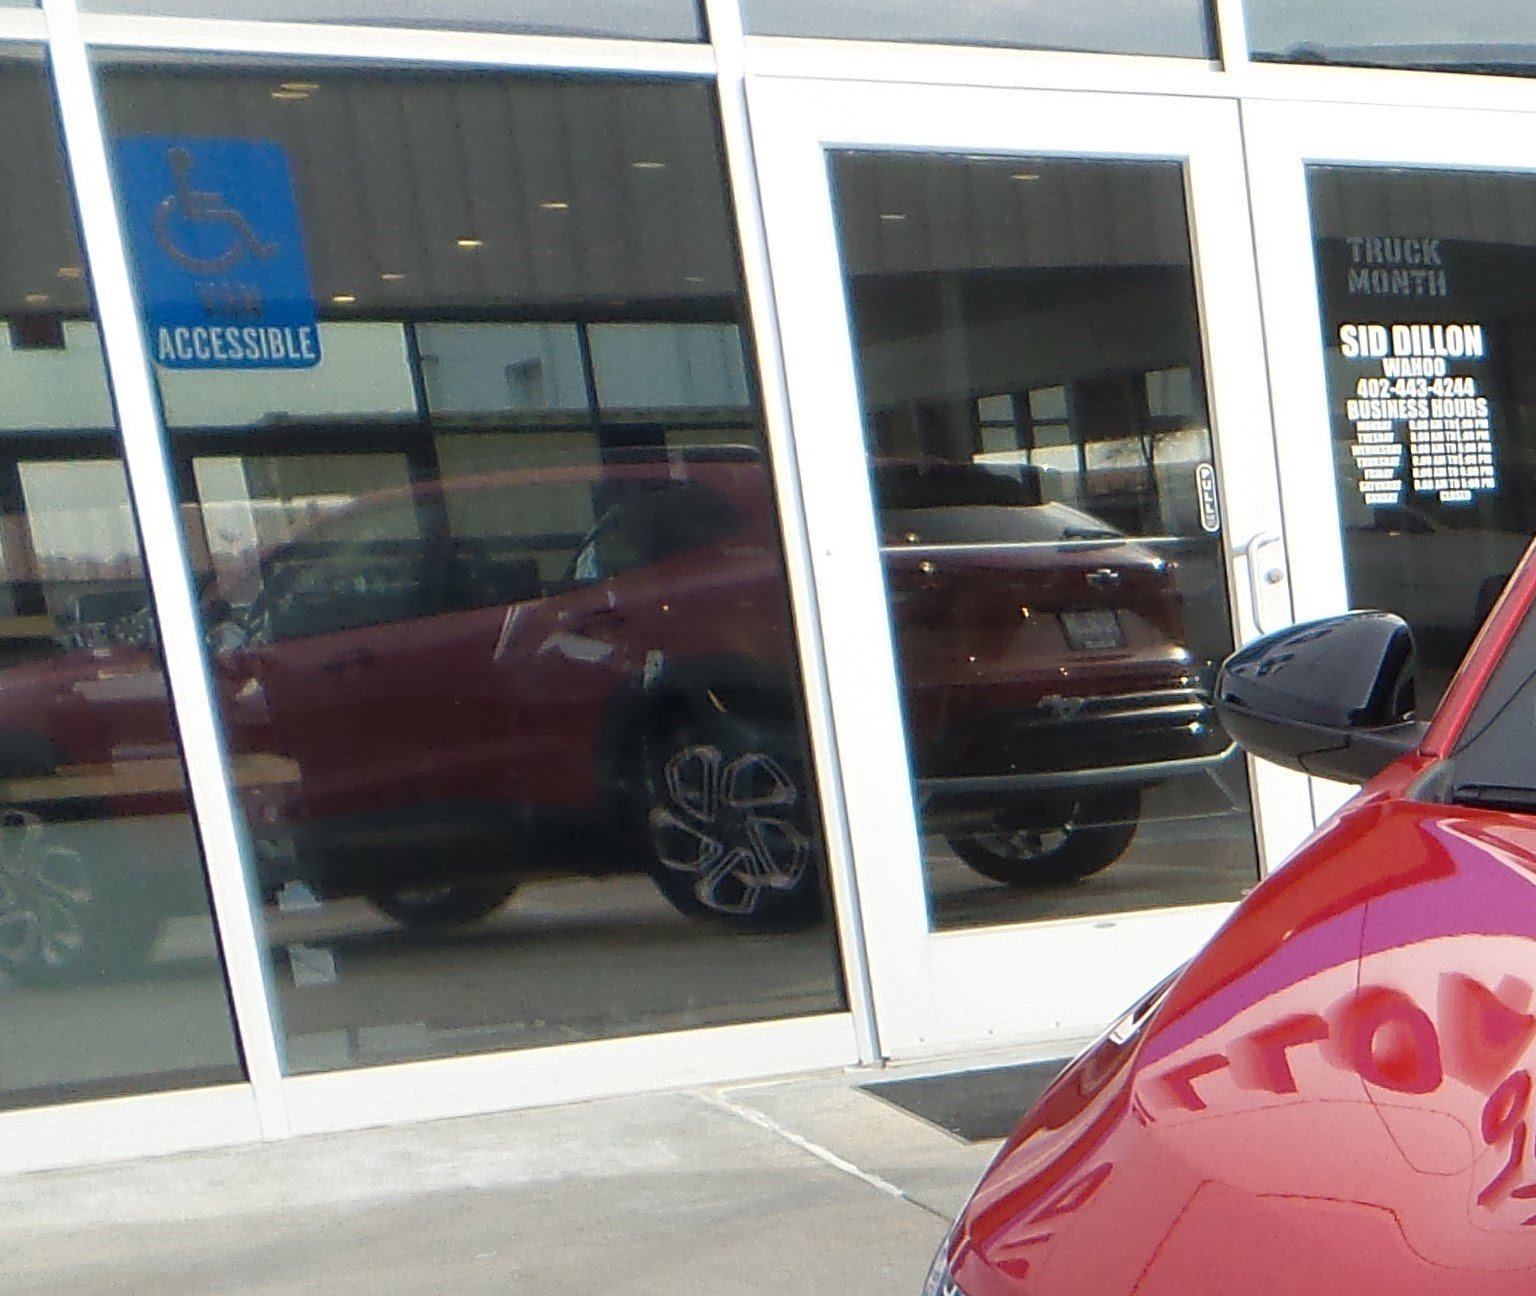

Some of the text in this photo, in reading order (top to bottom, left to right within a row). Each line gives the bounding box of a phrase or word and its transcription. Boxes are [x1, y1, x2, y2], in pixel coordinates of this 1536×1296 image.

[1347, 236, 1442, 264] TRUCK
[1348, 267, 1447, 297] MONTH
[157, 326, 316, 360] ACCESSIBLE
[1339, 324, 1483, 358] SID DILLON
[1382, 357, 1446, 378] WAHOO
[1356, 377, 1475, 398] 402-443-4244
[1346, 397, 1488, 420] BUSINESS HOURS
